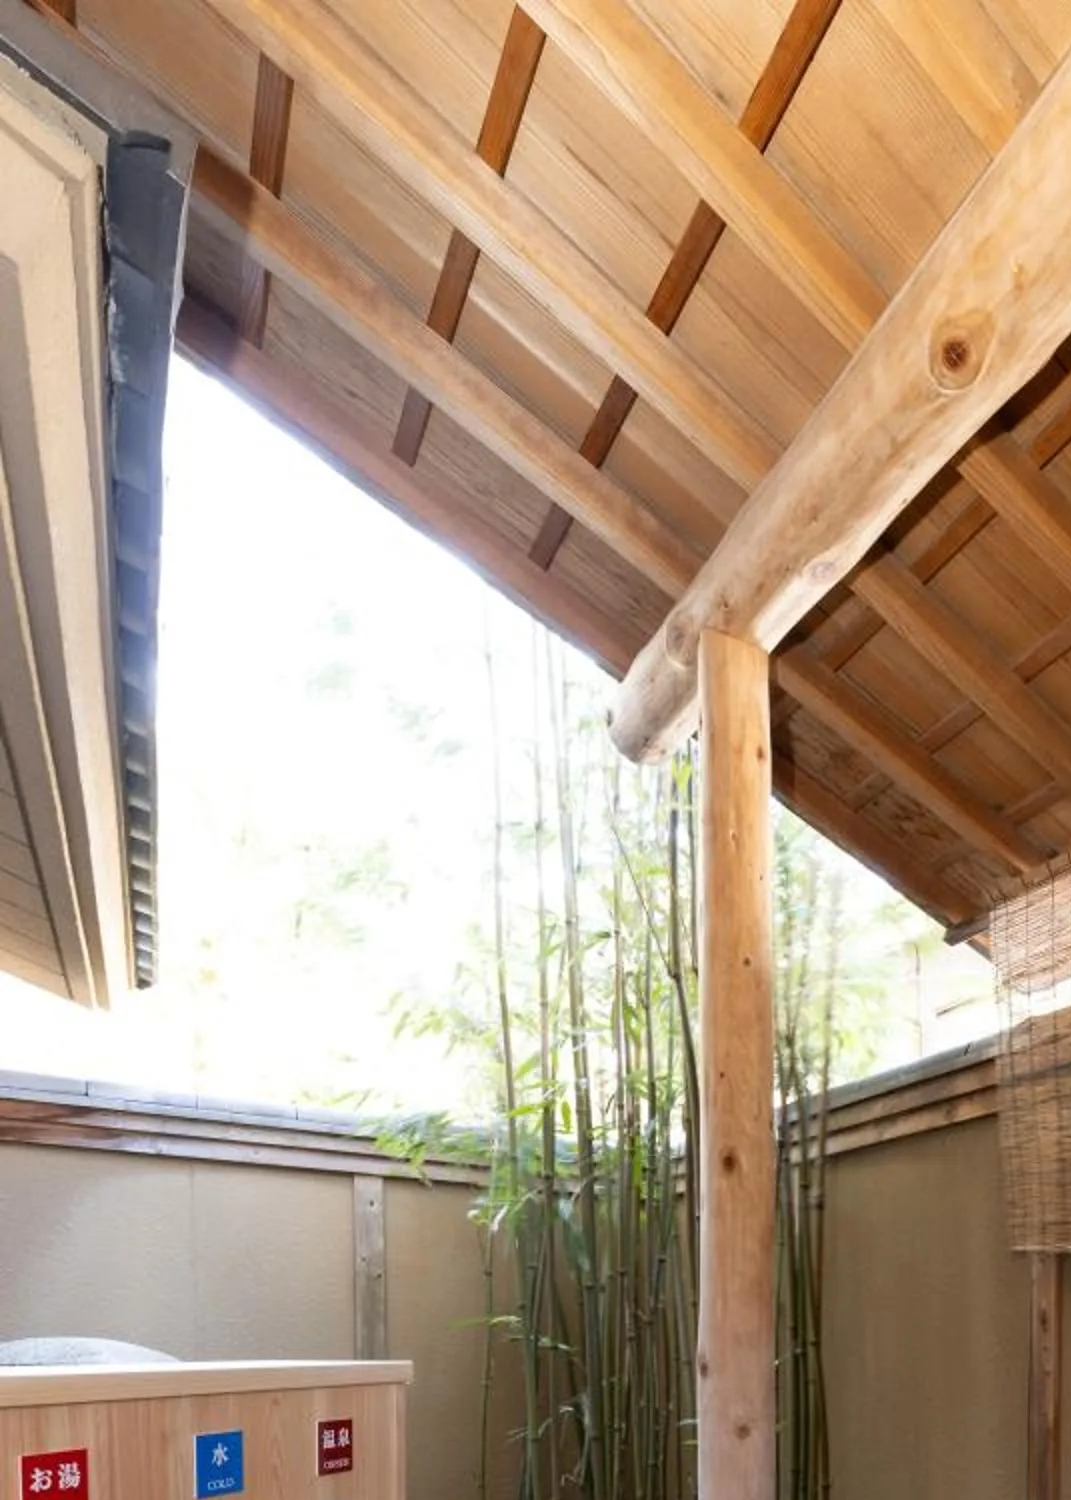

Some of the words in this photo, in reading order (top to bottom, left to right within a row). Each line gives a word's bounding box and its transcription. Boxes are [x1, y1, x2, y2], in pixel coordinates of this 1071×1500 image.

[212, 1441, 230, 1467] 水
[29, 1462, 80, 1493] お湯
[208, 1477, 235, 1491] COLD
